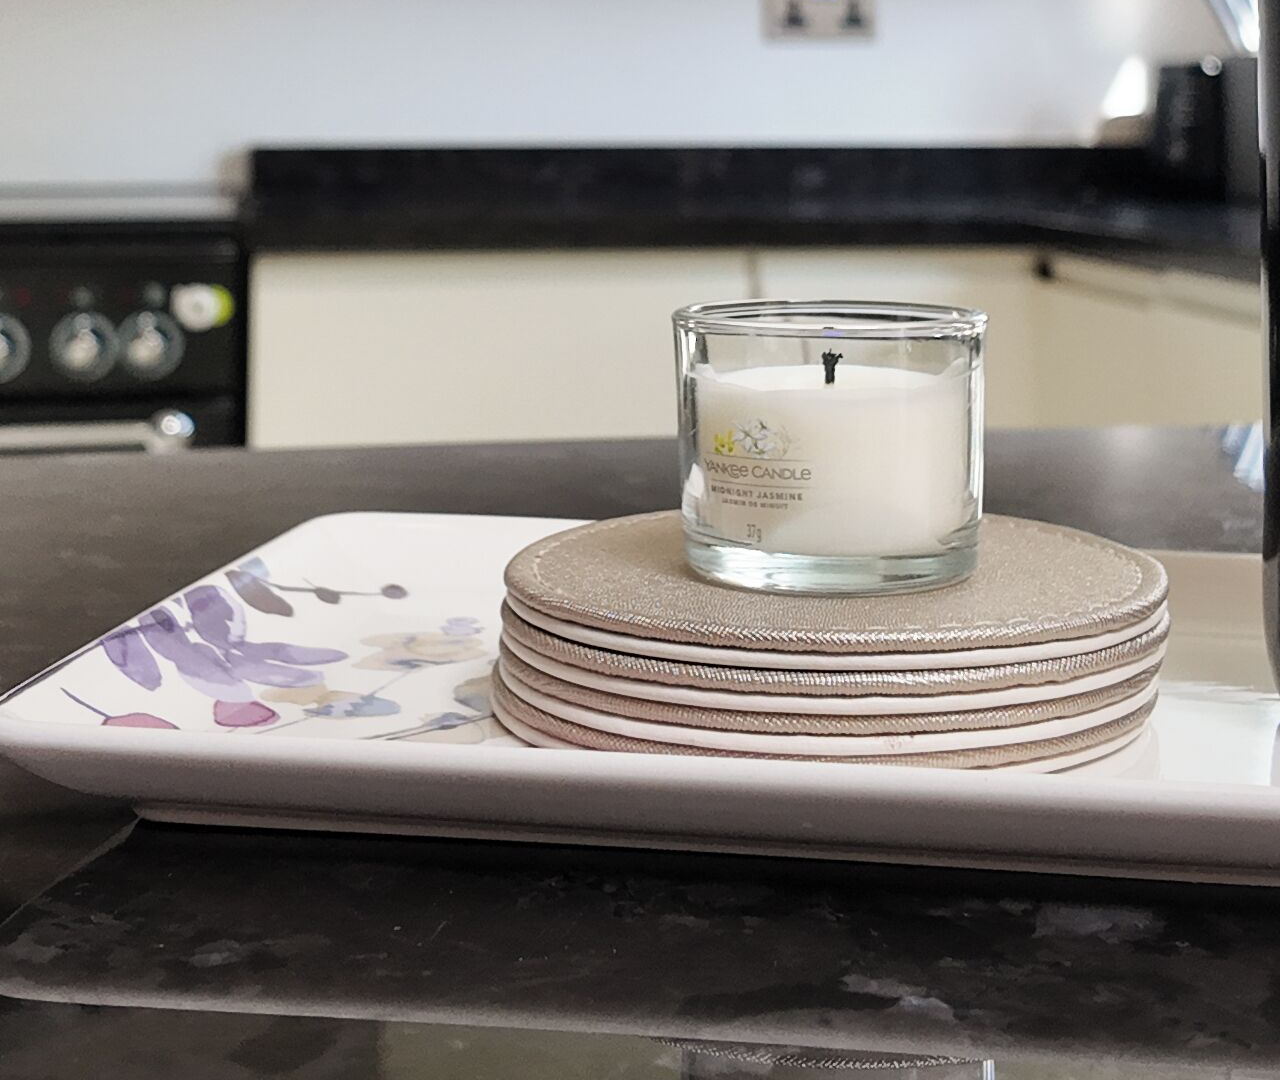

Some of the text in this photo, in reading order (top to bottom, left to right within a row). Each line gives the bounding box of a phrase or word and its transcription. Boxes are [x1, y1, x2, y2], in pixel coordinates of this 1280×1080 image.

[710, 484, 803, 501] MIDNIGHT JASMINE
[746, 523, 762, 543] 37g
